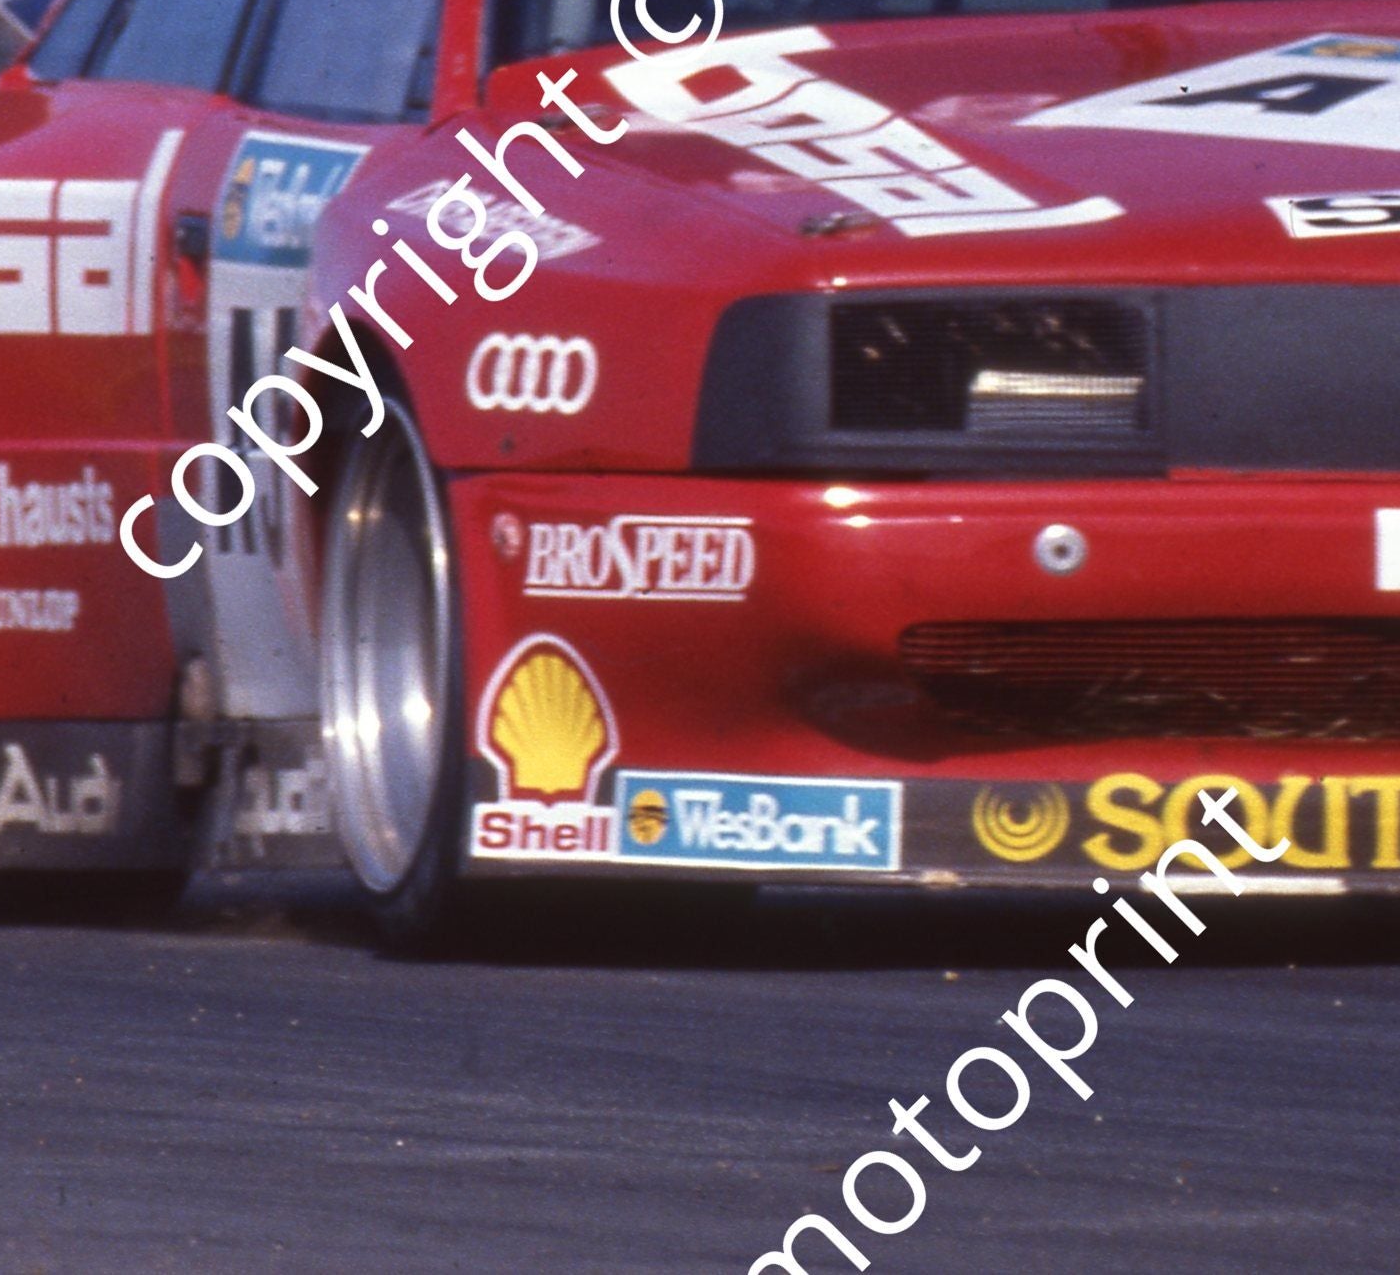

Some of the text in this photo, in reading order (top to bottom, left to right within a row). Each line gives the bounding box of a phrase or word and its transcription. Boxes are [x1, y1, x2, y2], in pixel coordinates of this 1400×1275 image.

[1140, 72, 1394, 115] A
[603, 25, 1127, 238] bosal
[478, 810, 610, 854] Shell
[674, 788, 879, 856] WesBank
